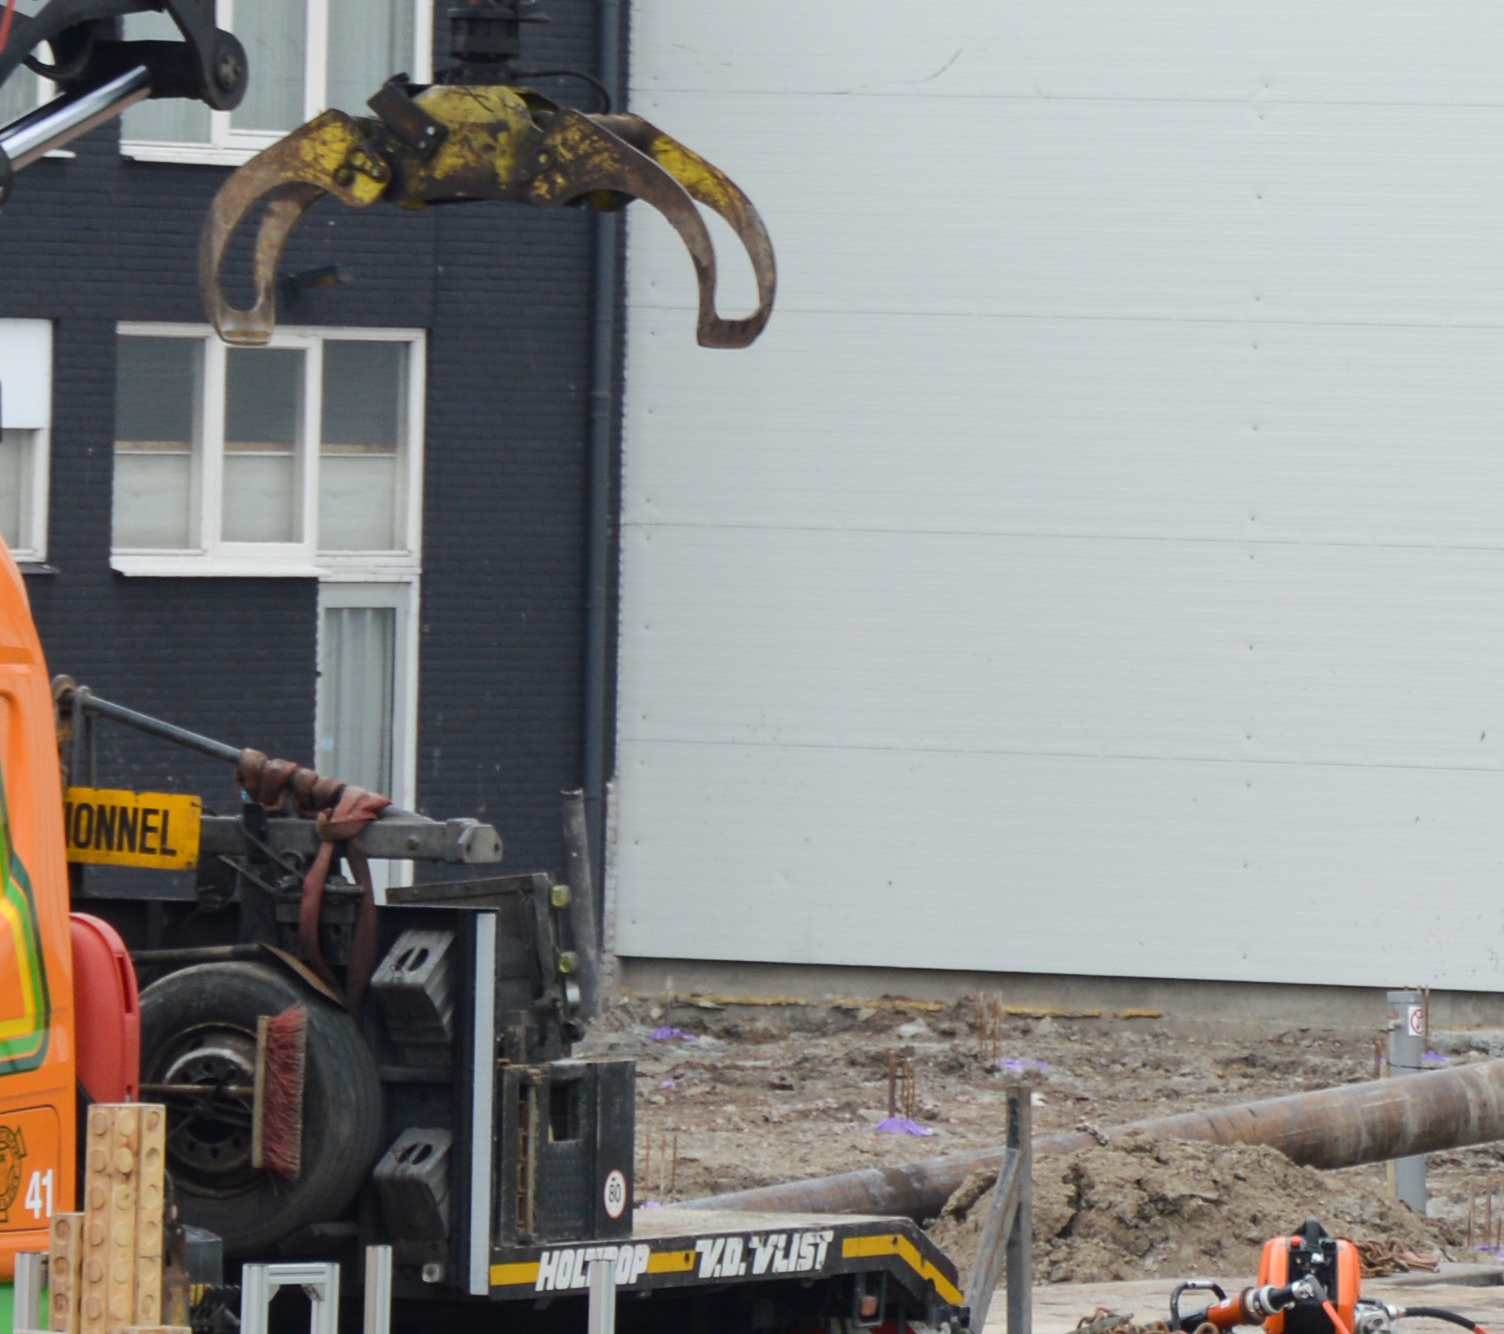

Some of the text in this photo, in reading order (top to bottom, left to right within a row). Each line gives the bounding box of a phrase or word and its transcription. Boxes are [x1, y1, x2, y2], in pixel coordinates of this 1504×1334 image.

[24, 1168, 53, 1219] 41
[609, 1183, 621, 1203] 80
[696, 1237, 746, 1279] V.D.
[748, 1230, 834, 1276] VLIST
